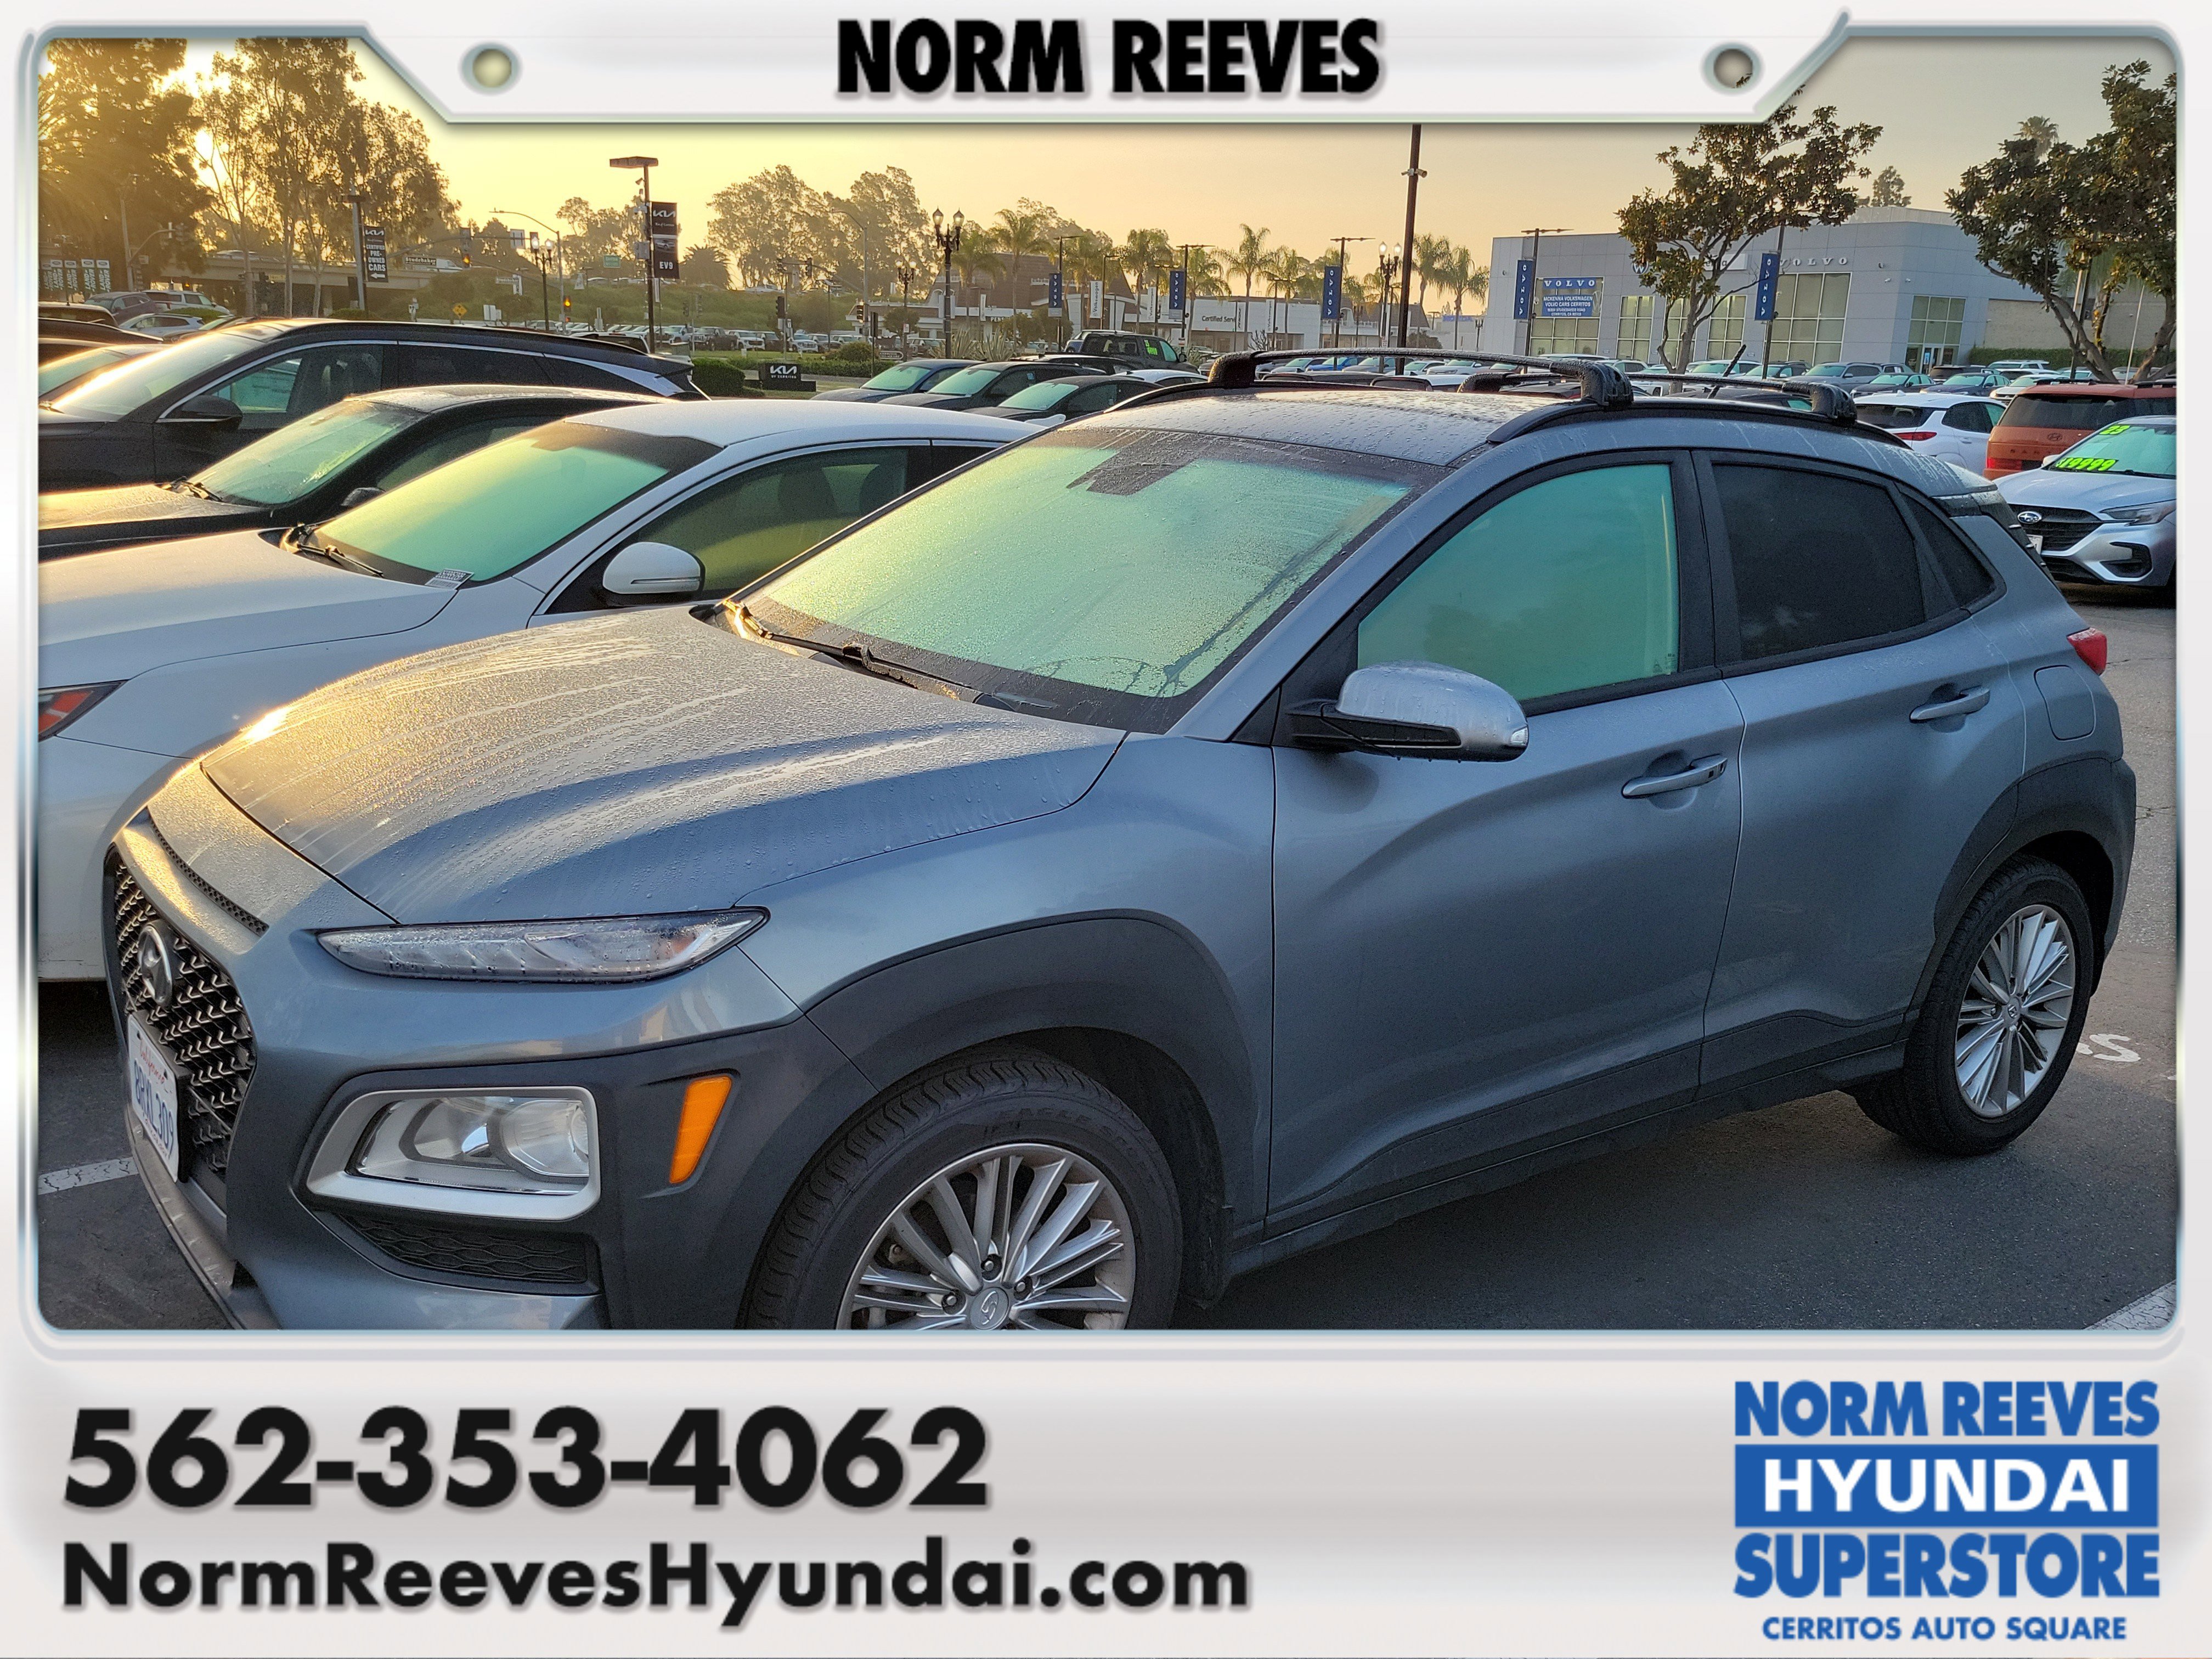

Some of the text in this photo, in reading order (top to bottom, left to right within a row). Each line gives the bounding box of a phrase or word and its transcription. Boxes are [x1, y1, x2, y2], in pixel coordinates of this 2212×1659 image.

[659, 261, 673, 269] EV9
[1779, 257, 1848, 267] VOLVO
[1519, 264, 1527, 315] VOLVO
[134, 1058, 174, 1161] 8RXL309
